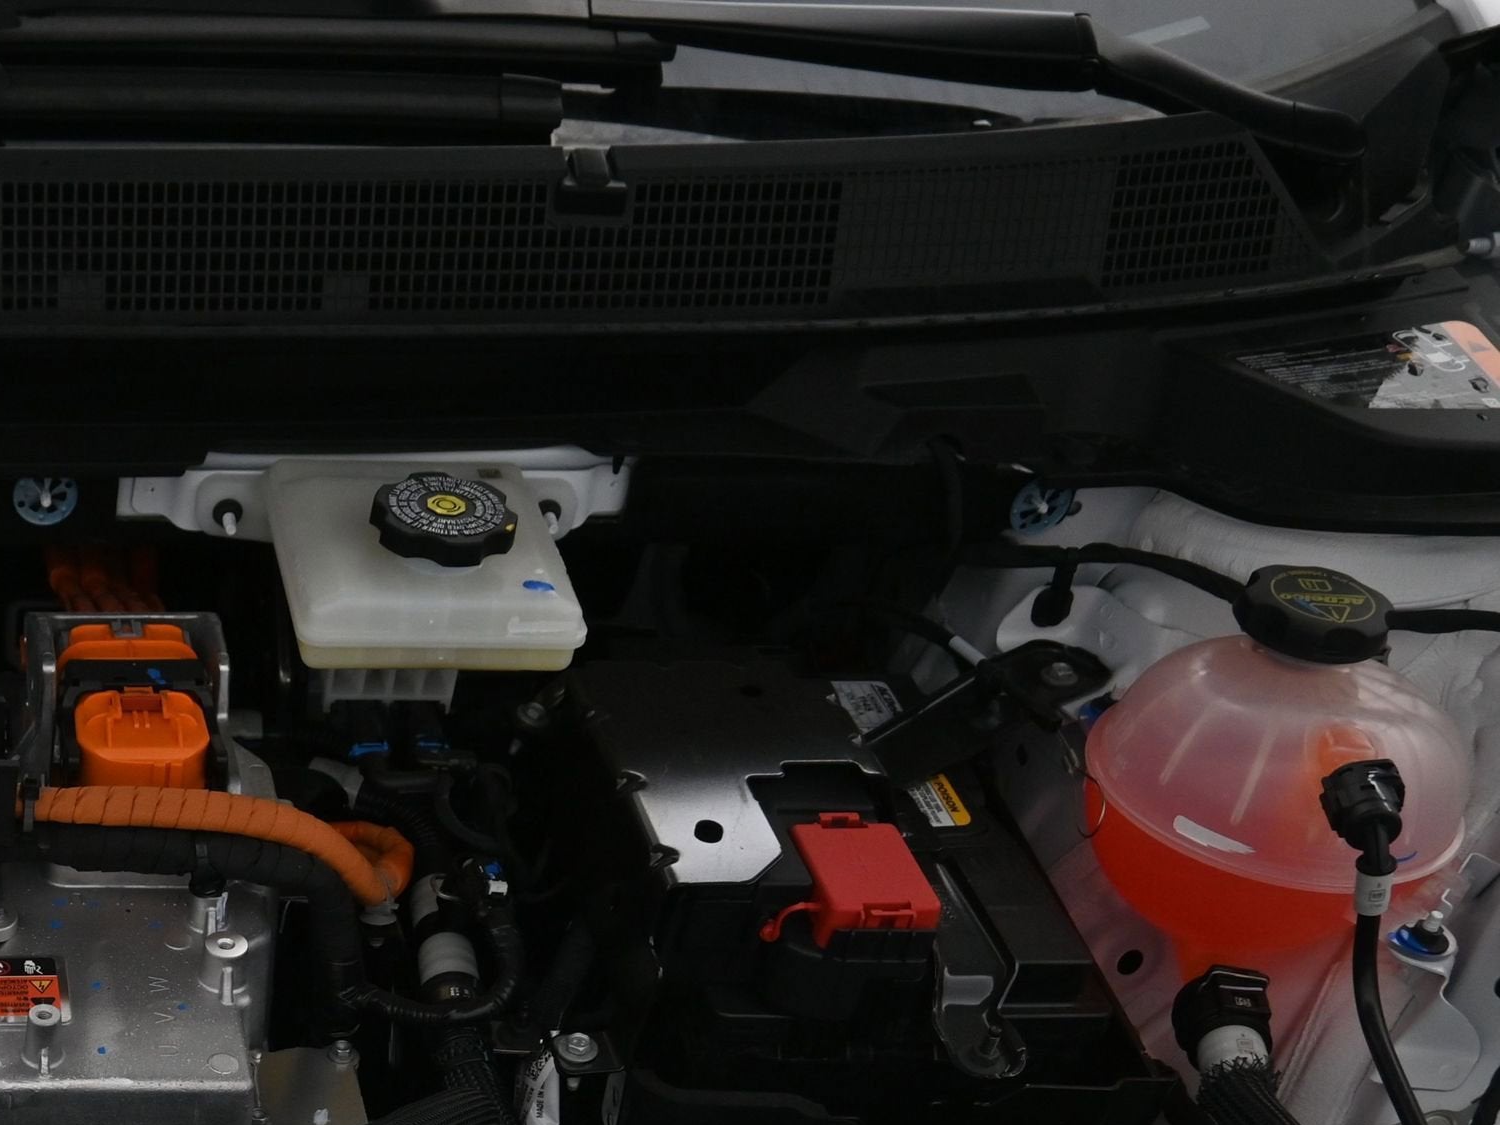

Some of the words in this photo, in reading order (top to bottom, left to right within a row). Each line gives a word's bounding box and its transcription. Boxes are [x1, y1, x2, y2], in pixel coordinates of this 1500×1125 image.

[934, 782, 960, 813] POISON
[148, 976, 171, 993] W
[153, 1011, 176, 1024] V
[536, 1100, 544, 1118] MADE
